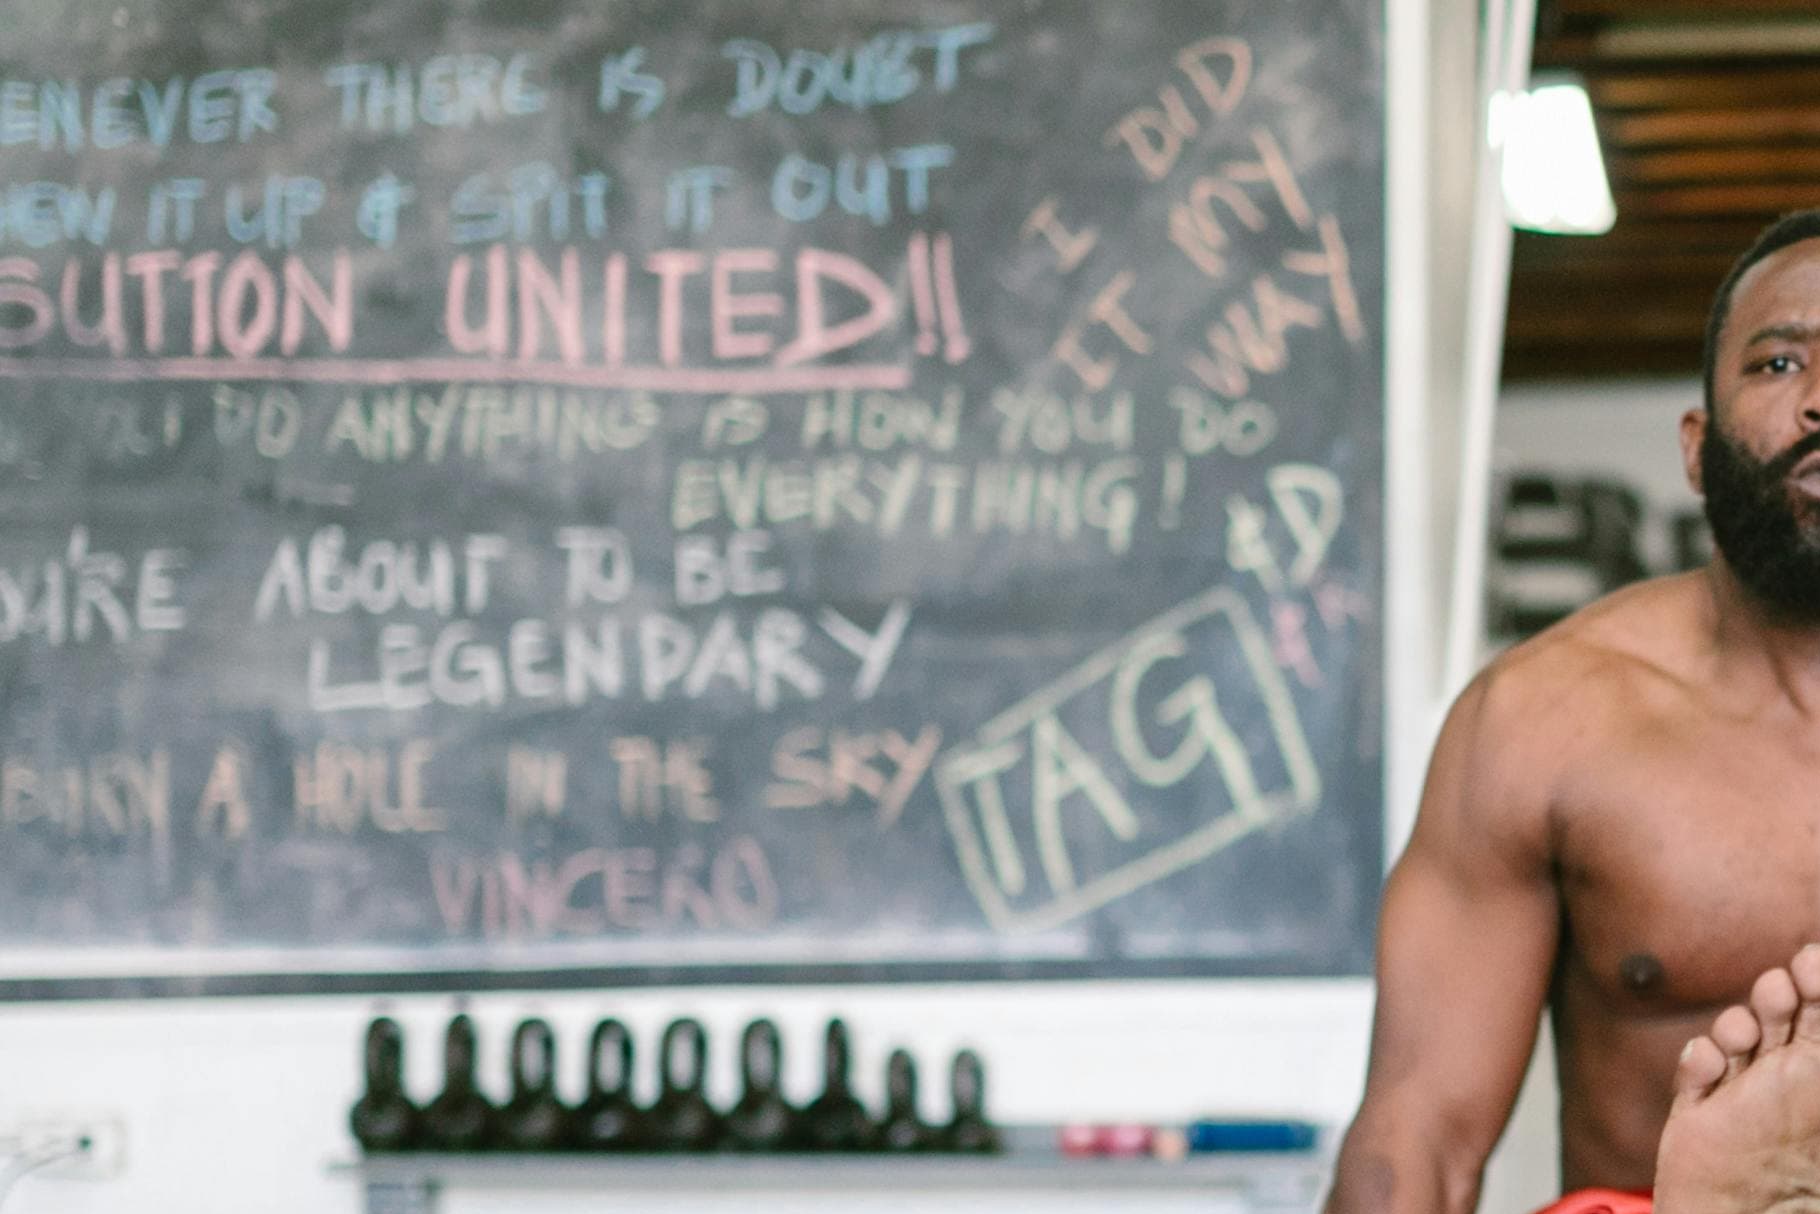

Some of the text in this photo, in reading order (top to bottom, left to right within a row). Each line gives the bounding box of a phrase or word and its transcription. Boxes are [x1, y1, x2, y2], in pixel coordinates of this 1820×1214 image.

[326, 52, 550, 132] THERE
[598, 45, 666, 120] IS
[722, 22, 996, 118] DOUBT
[1106, 36, 1253, 182] DID
[147, 176, 207, 247] IT
[225, 173, 327, 248] UP
[664, 165, 736, 234] IT
[770, 143, 956, 227] OUT
[1167, 126, 1313, 279] MY
[0, 231, 972, 370] SUTTON UNITED!!
[1182, 212, 1365, 399] WAY
[325, 380, 662, 465] ANYTHING
[802, 378, 965, 452] HOW
[994, 383, 1136, 454] YOU
[1168, 385, 1279, 456] DO
[255, 524, 510, 624] ABOUT
[555, 525, 636, 604] TO
[674, 530, 786, 605] BE
[307, 602, 916, 712] LEGENDARY
[293, 742, 448, 835] HOLE
[610, 735, 722, 824] THE
[767, 724, 945, 830] SKY
[945, 628, 1270, 899] TAG
